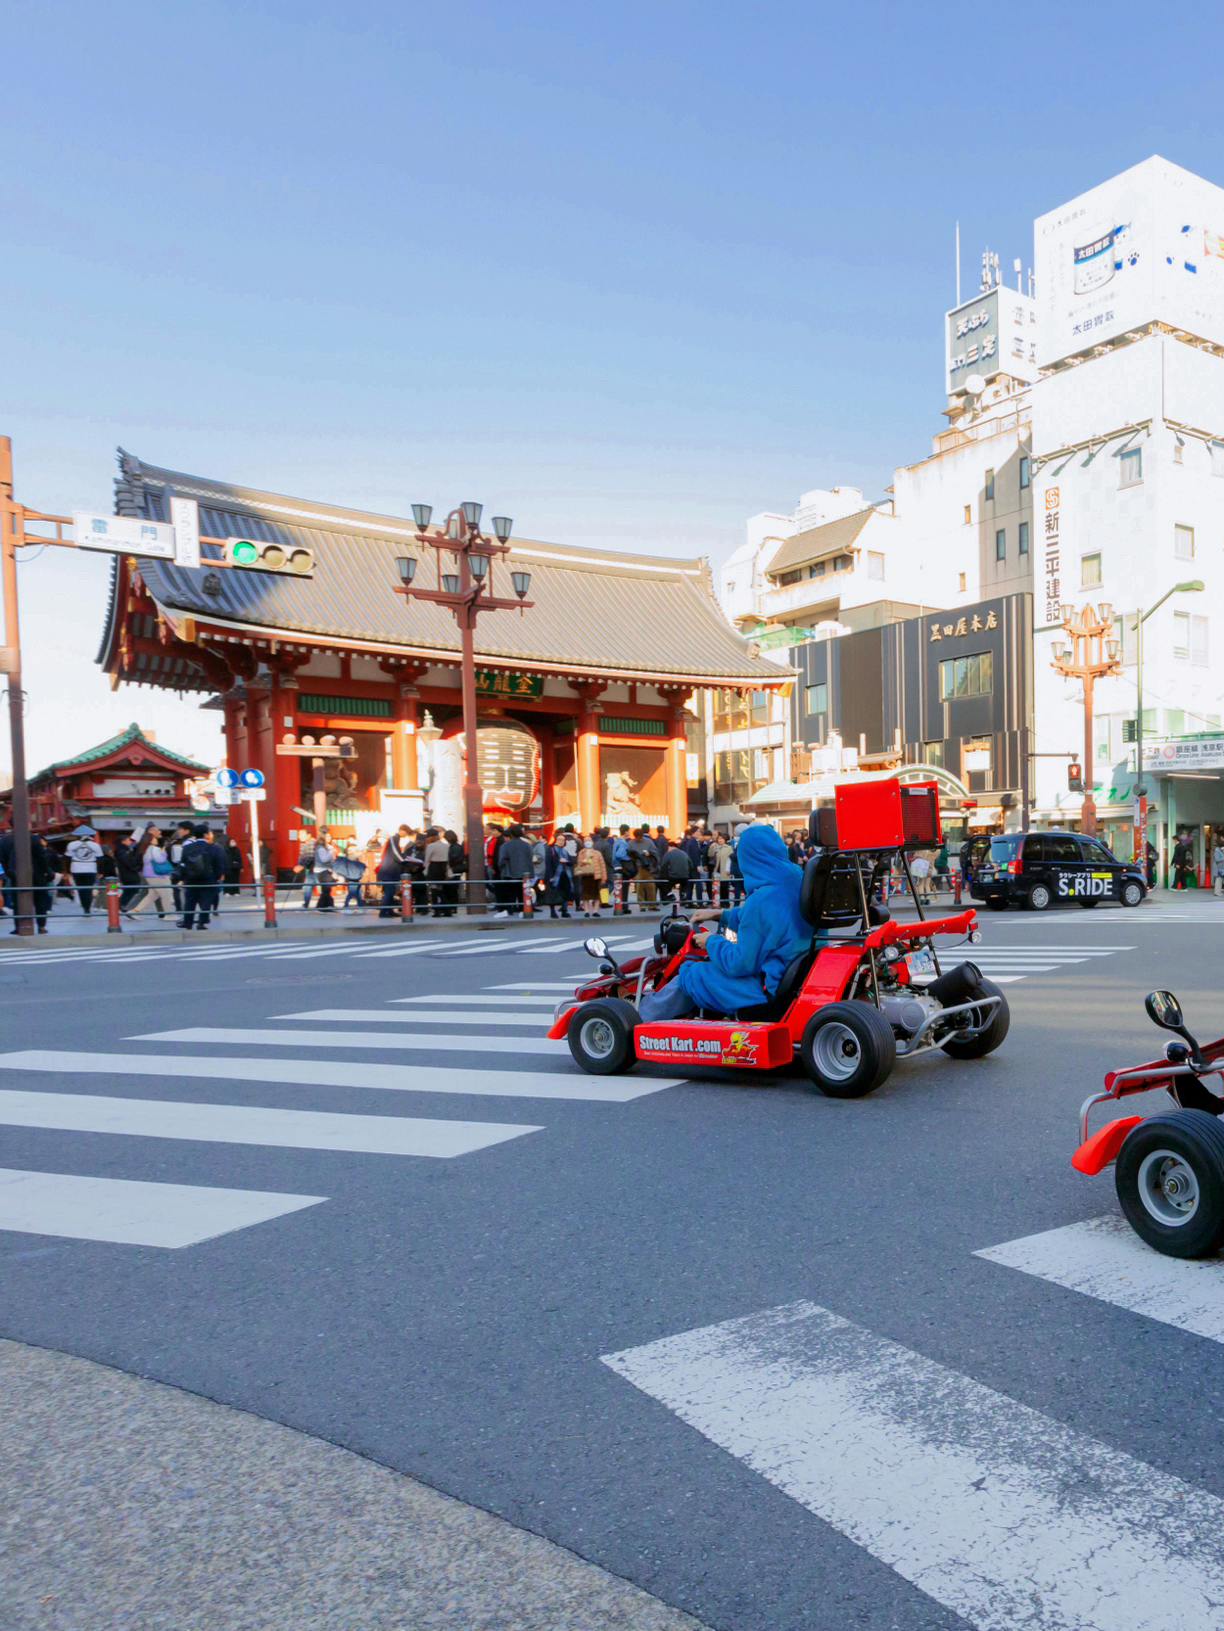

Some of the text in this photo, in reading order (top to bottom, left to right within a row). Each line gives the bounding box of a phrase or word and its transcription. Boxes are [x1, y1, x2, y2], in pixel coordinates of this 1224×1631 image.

[1045, 511, 1060, 623] 新三平建設
[930, 610, 998, 642] 黒田屋本店
[1058, 878, 1113, 897] S.RIDE
[639, 1035, 722, 1053] Street Kart .com
